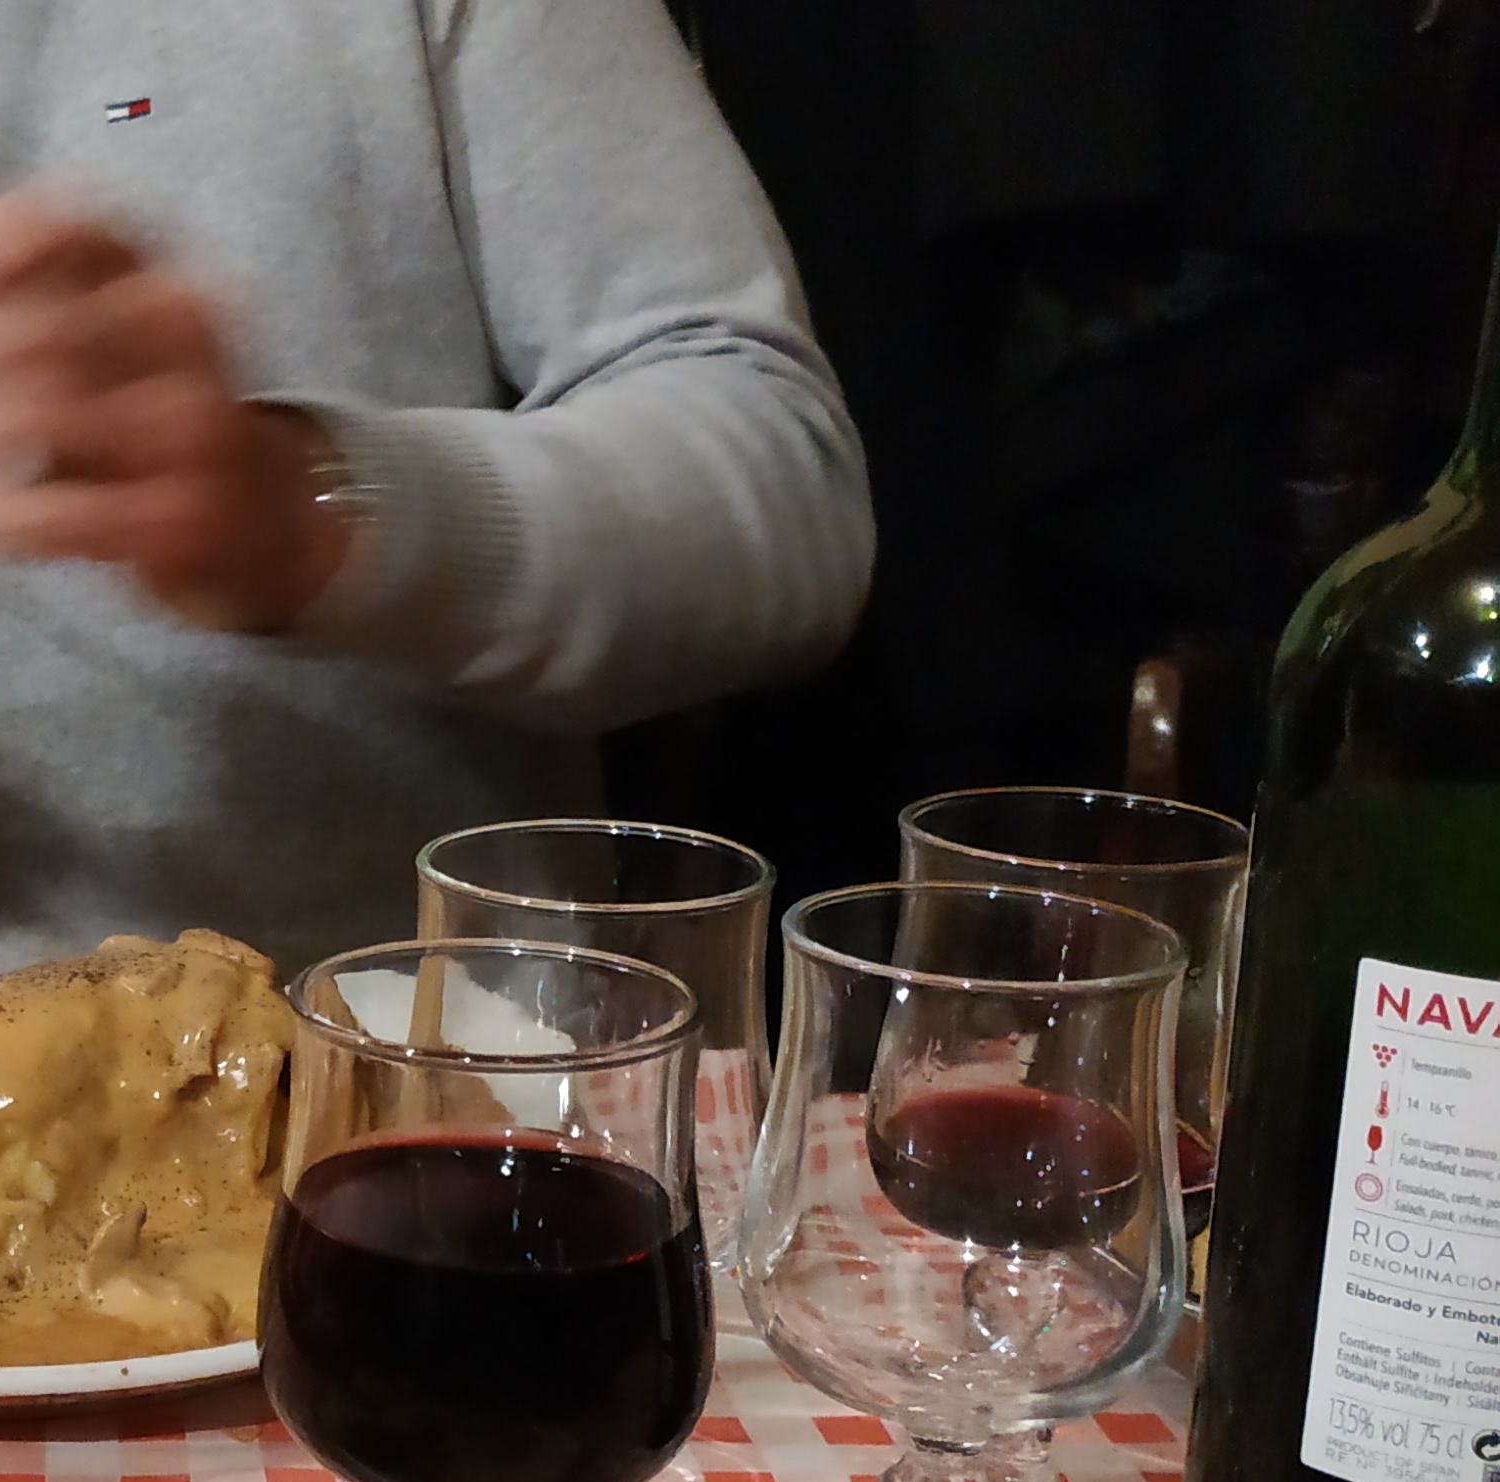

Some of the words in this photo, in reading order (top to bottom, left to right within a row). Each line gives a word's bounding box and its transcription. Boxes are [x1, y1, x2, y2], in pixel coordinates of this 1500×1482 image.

[1375, 981, 1500, 1038] NAV
[1411, 1057, 1473, 1080] Tempranillo
[1407, 1096, 1420, 1110] 14
[1400, 1132, 1421, 1148] Con
[1352, 1219, 1457, 1264] RIOJA
[1345, 1281, 1422, 1312] Elaborado
[1426, 1305, 1436, 1318] y
[1339, 1331, 1391, 1357] Contiene
[1396, 1347, 1441, 1368] Sulfitos
[1335, 1364, 1390, 1392] Obsahuje
[1381, 1360, 1420, 1381] Sulfite
[1329, 1397, 1375, 1440] 13,5%
[1382, 1419, 1410, 1448] vol
[1419, 1421, 1441, 1455] 75
[1447, 1428, 1465, 1460] cl
[1326, 1436, 1389, 1463] PRODUCT
[1395, 1456, 1414, 1468] OF
[1420, 1461, 1461, 1479] SPAIN
